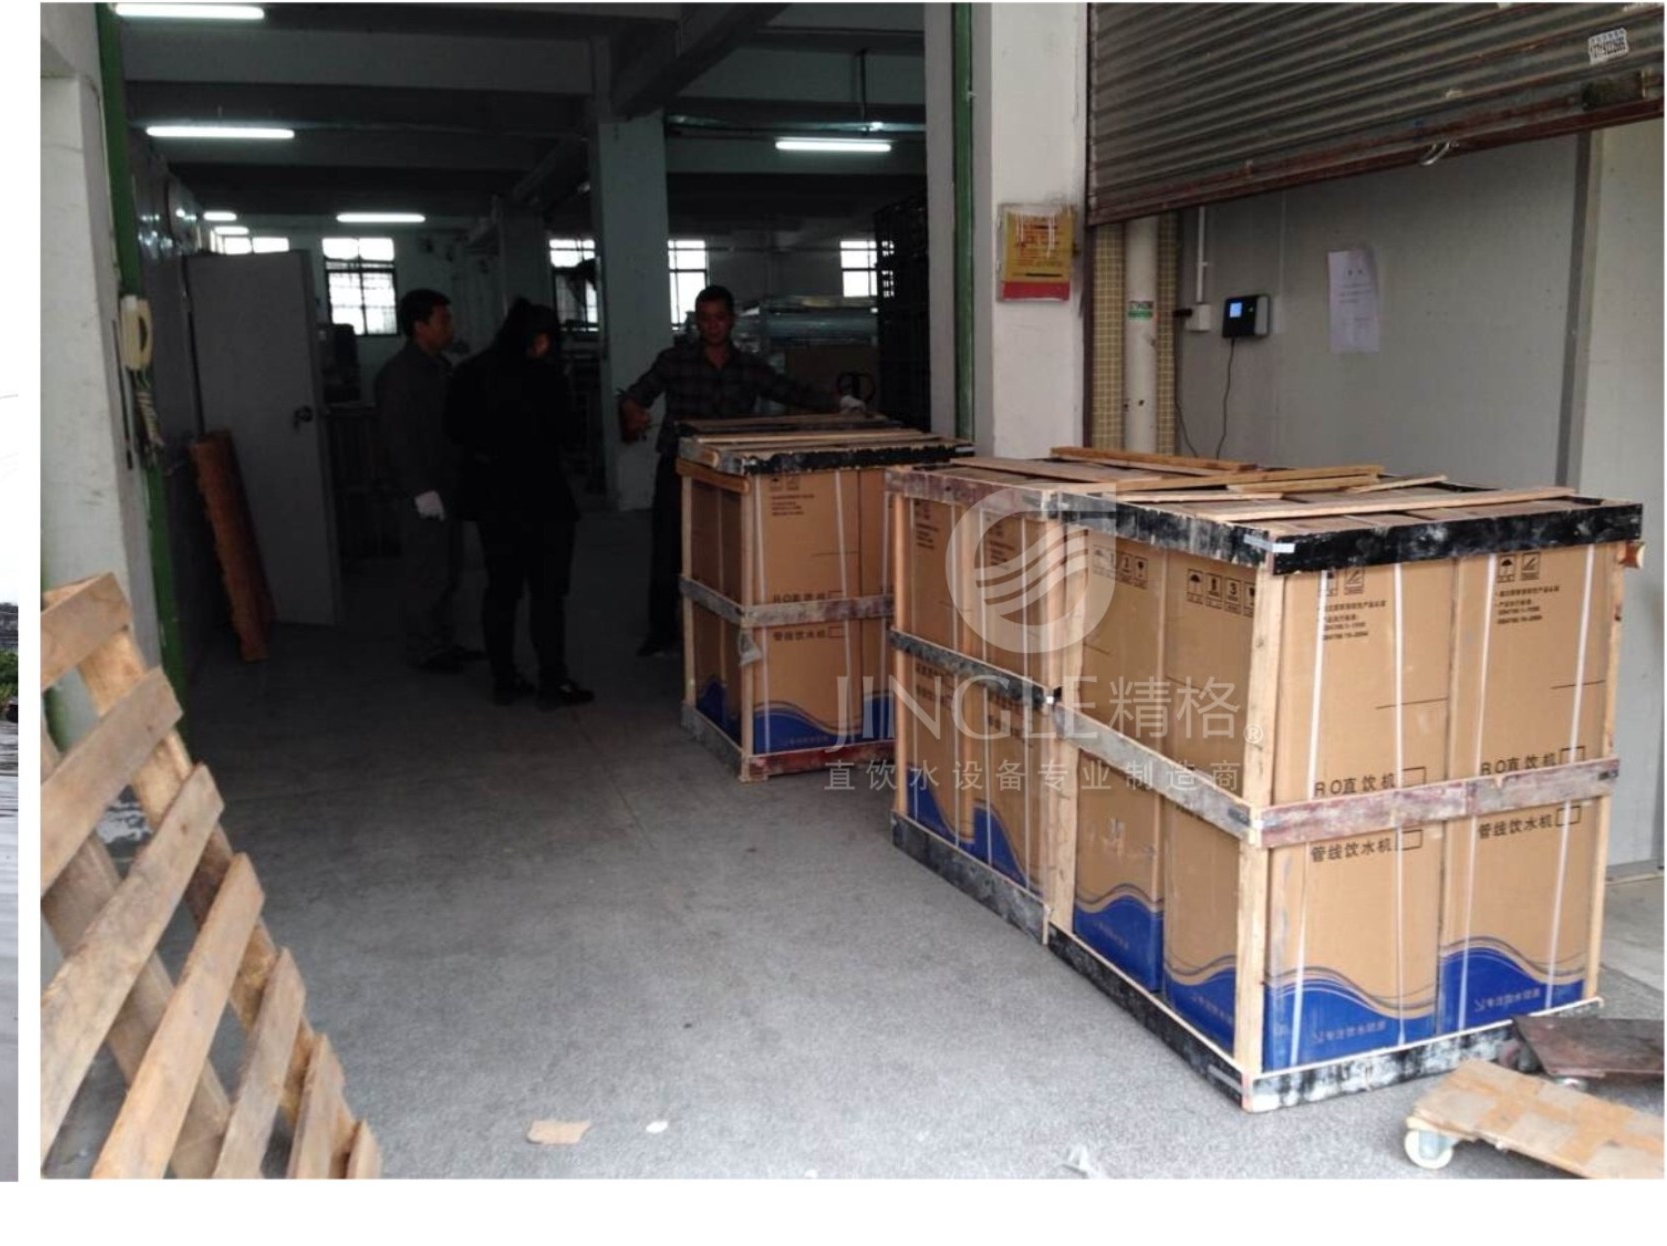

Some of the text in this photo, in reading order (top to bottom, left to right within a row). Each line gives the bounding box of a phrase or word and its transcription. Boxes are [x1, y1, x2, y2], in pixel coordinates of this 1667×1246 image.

[1478, 814, 1552, 839] 管线饮水机
[1311, 838, 1392, 863] 管线饮水机
